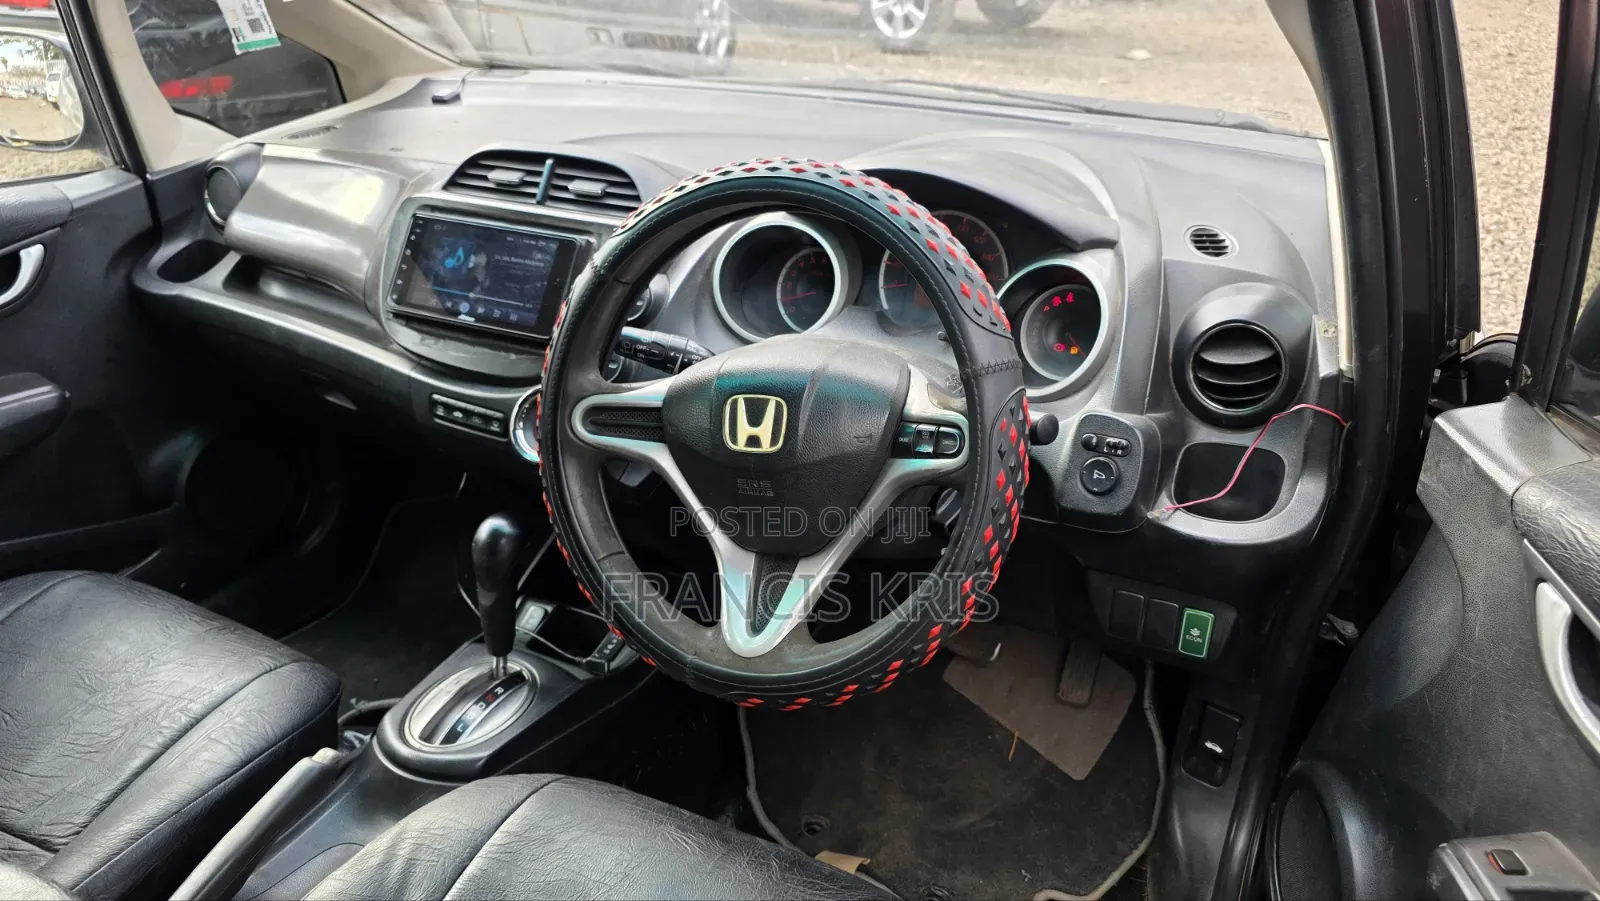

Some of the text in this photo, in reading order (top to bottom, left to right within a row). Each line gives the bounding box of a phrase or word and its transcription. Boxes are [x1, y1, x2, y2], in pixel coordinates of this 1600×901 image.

[737, 479, 771, 488] SRS
[738, 488, 774, 497] AIRBAG
[1186, 634, 1203, 643] ECON
[494, 686, 504, 695] R
[485, 694, 495, 702] N
[477, 702, 486, 710] D
[456, 723, 464, 732] L
